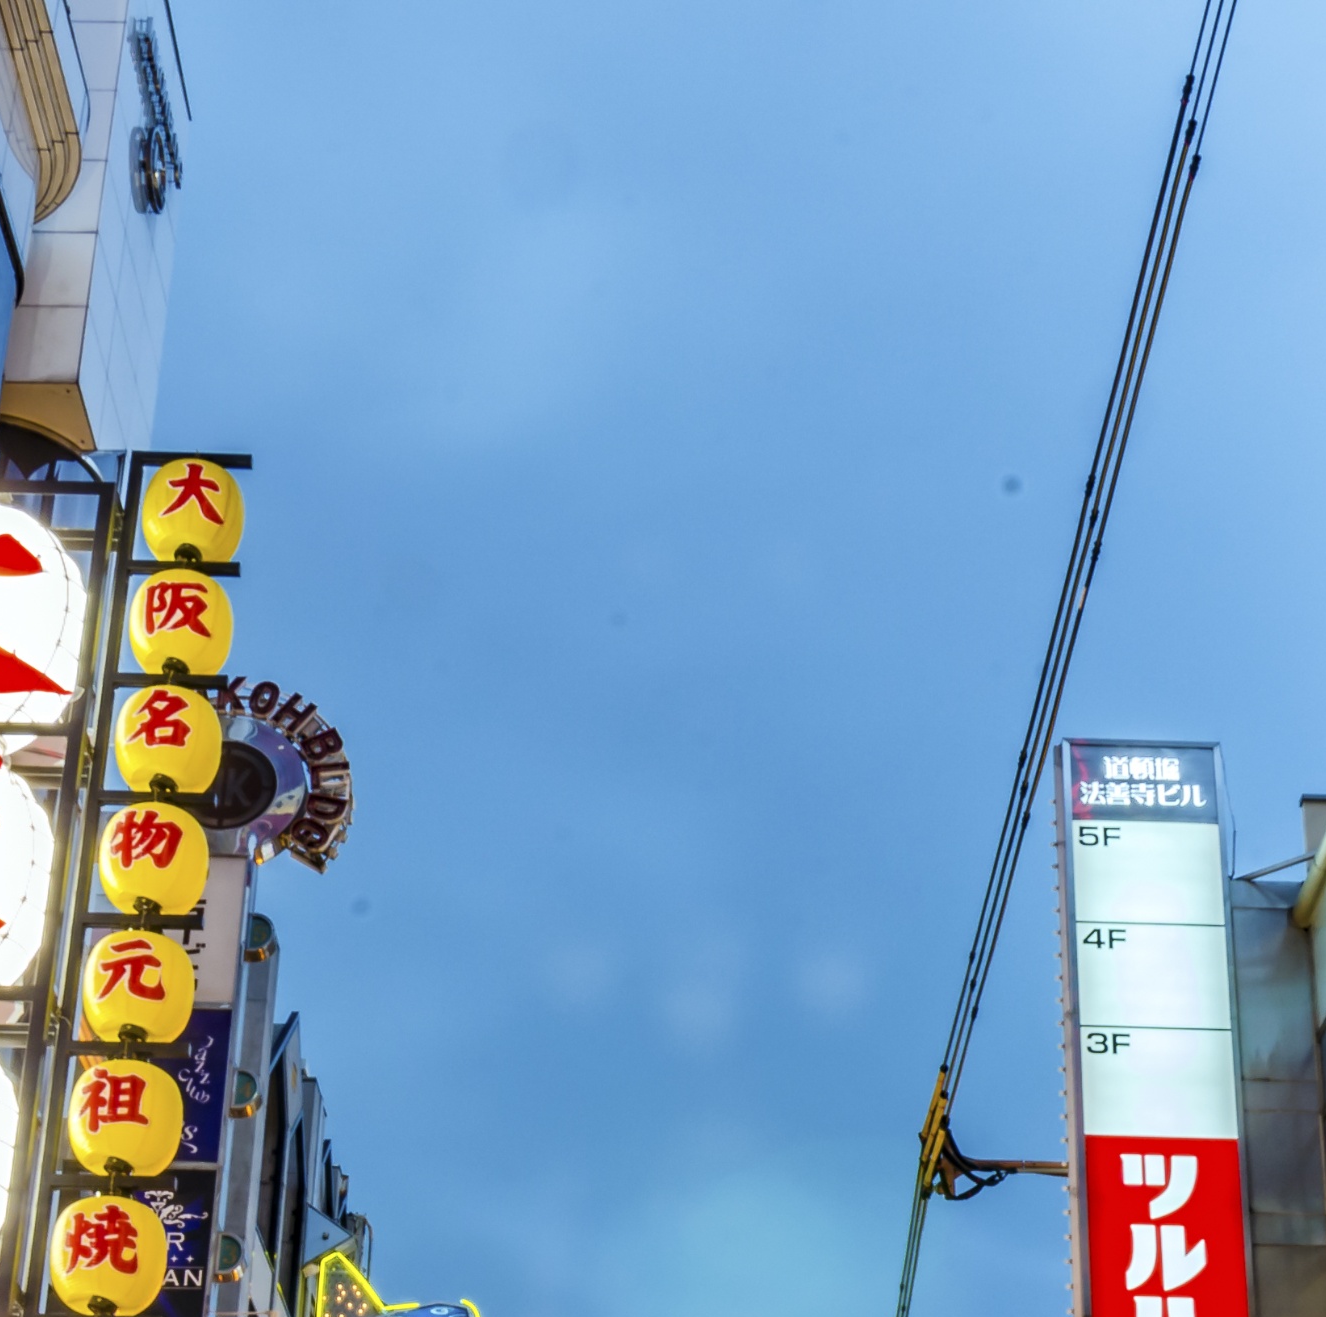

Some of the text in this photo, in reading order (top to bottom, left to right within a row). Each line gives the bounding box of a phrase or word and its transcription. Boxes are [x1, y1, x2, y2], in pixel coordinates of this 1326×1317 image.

[1102, 756, 1181, 781] 道頓堀
[291, 728, 351, 849] BLDG
[1079, 781, 1207, 808] 法善寺ビル
[1078, 826, 1121, 847] 5F
[1082, 929, 1127, 949] 4F
[1087, 1033, 1131, 1055] 3F
